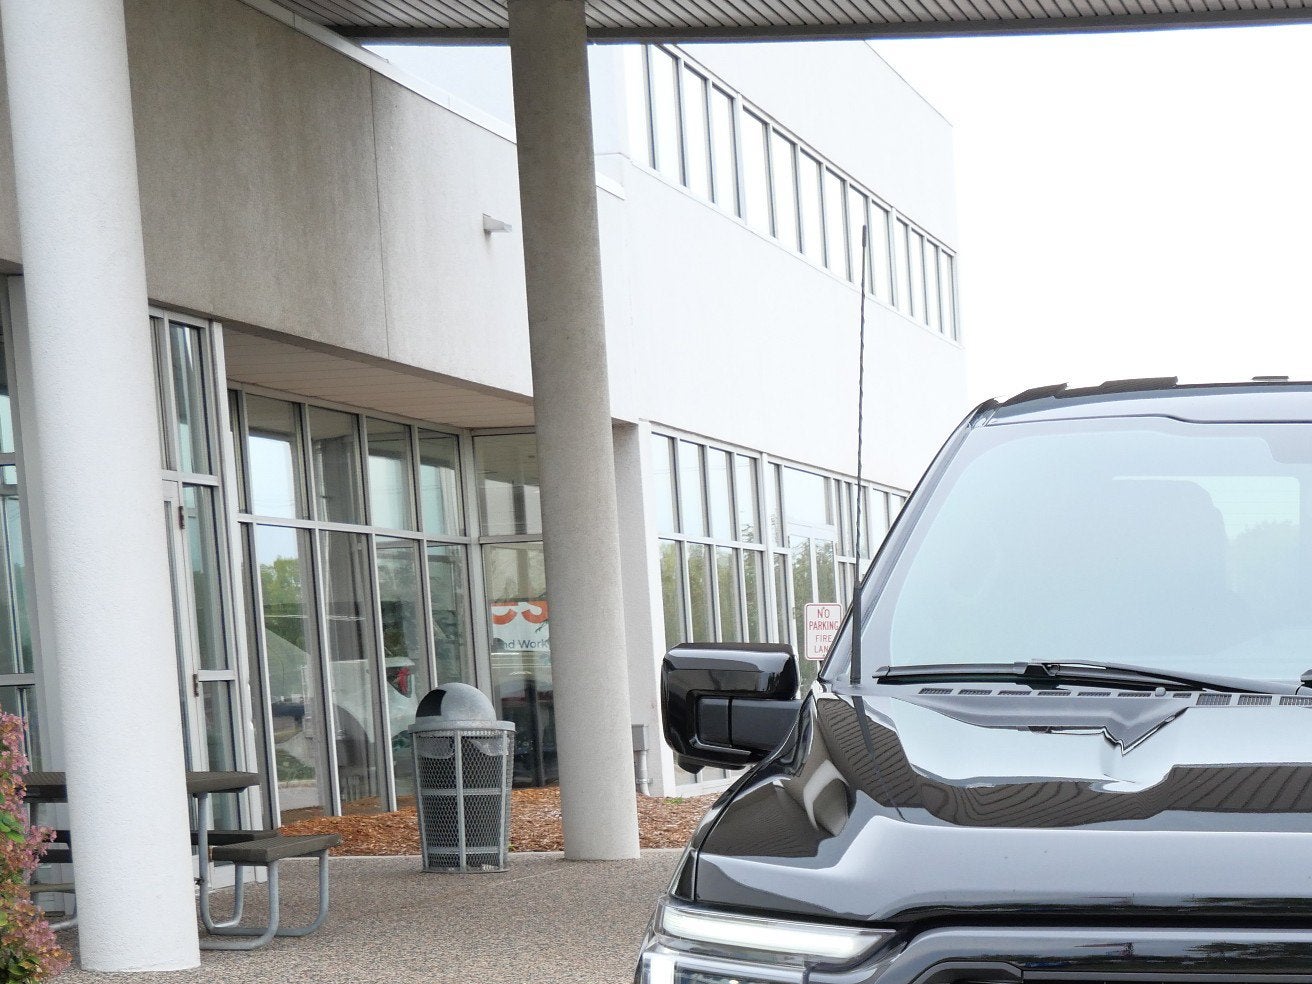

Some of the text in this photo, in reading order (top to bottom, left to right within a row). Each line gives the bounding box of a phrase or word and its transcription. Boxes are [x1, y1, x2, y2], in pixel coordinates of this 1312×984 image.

[817, 609, 830, 618] NO
[809, 621, 839, 630] PARKING
[815, 634, 832, 643] FIRE
[814, 645, 829, 654] LAN
